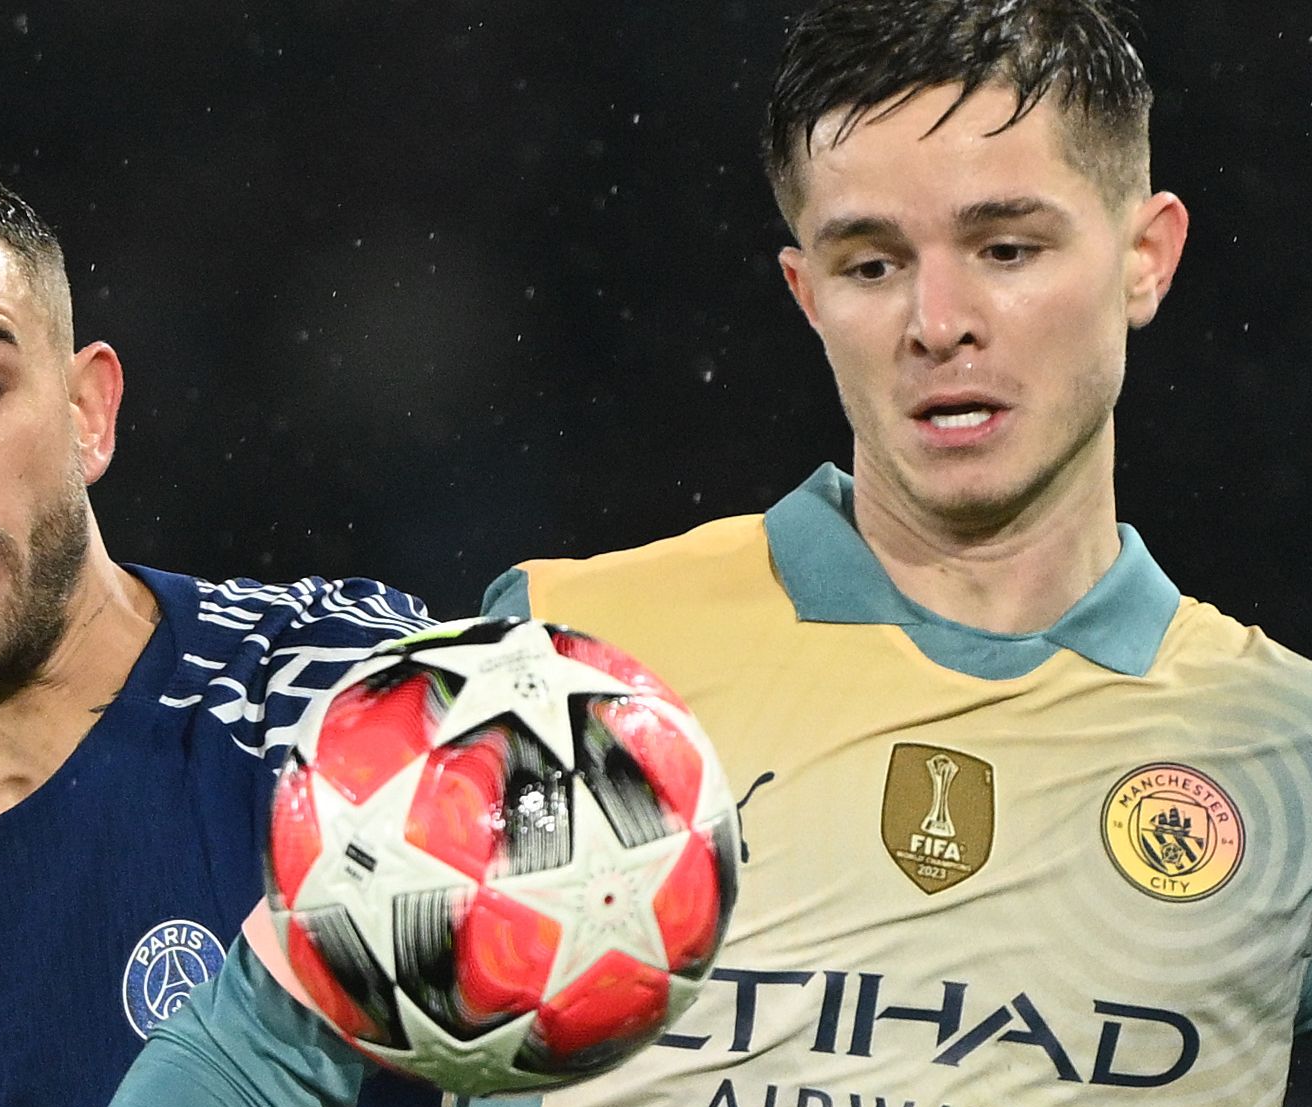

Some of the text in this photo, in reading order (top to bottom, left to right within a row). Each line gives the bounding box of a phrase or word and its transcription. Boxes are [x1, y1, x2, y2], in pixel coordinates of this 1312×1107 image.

[1119, 774, 1229, 824] MANCHESTER
[909, 833, 961, 862] FIFA
[917, 864, 947, 880] 2023
[1150, 876, 1190, 893] CITY
[136, 926, 204, 967] PARIS
